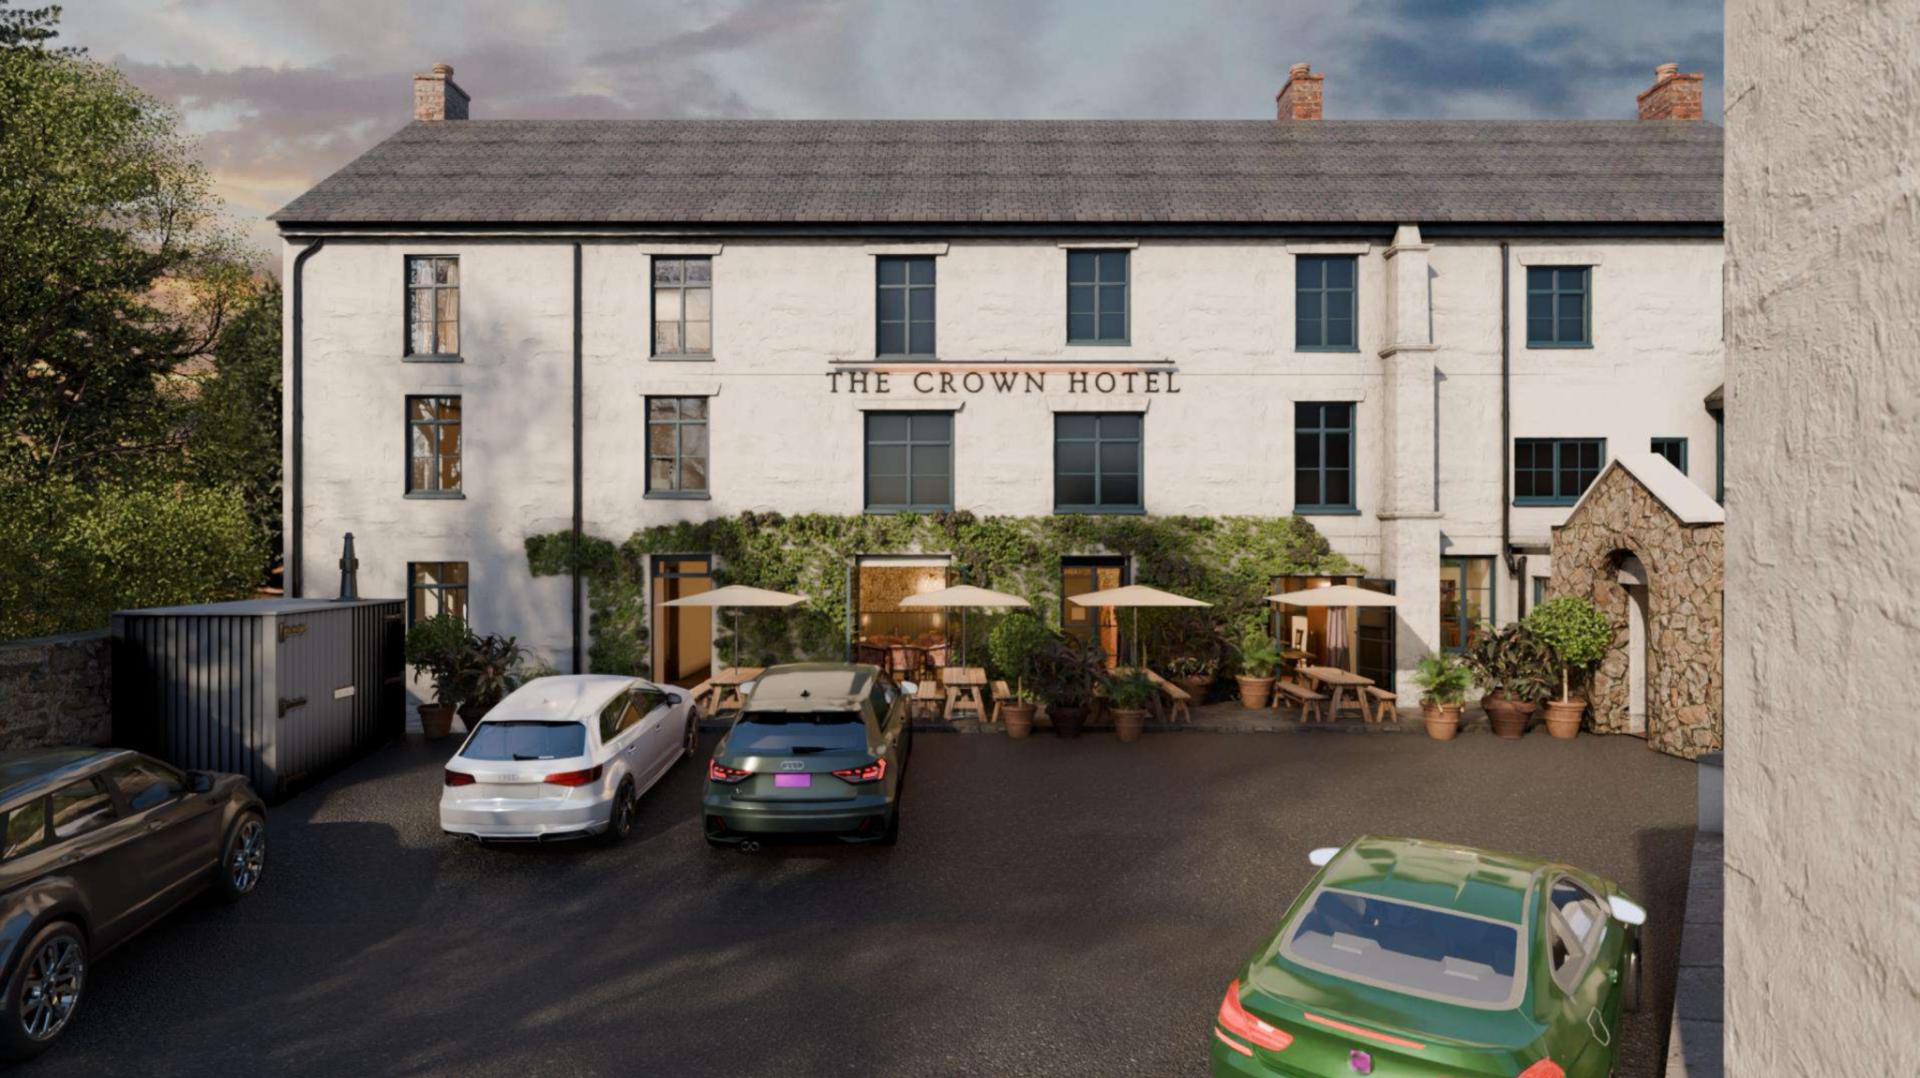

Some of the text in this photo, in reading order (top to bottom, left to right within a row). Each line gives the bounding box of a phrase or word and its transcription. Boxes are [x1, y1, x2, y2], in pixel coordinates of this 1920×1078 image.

[826, 371, 1181, 393] THE CROWN HOTEL
